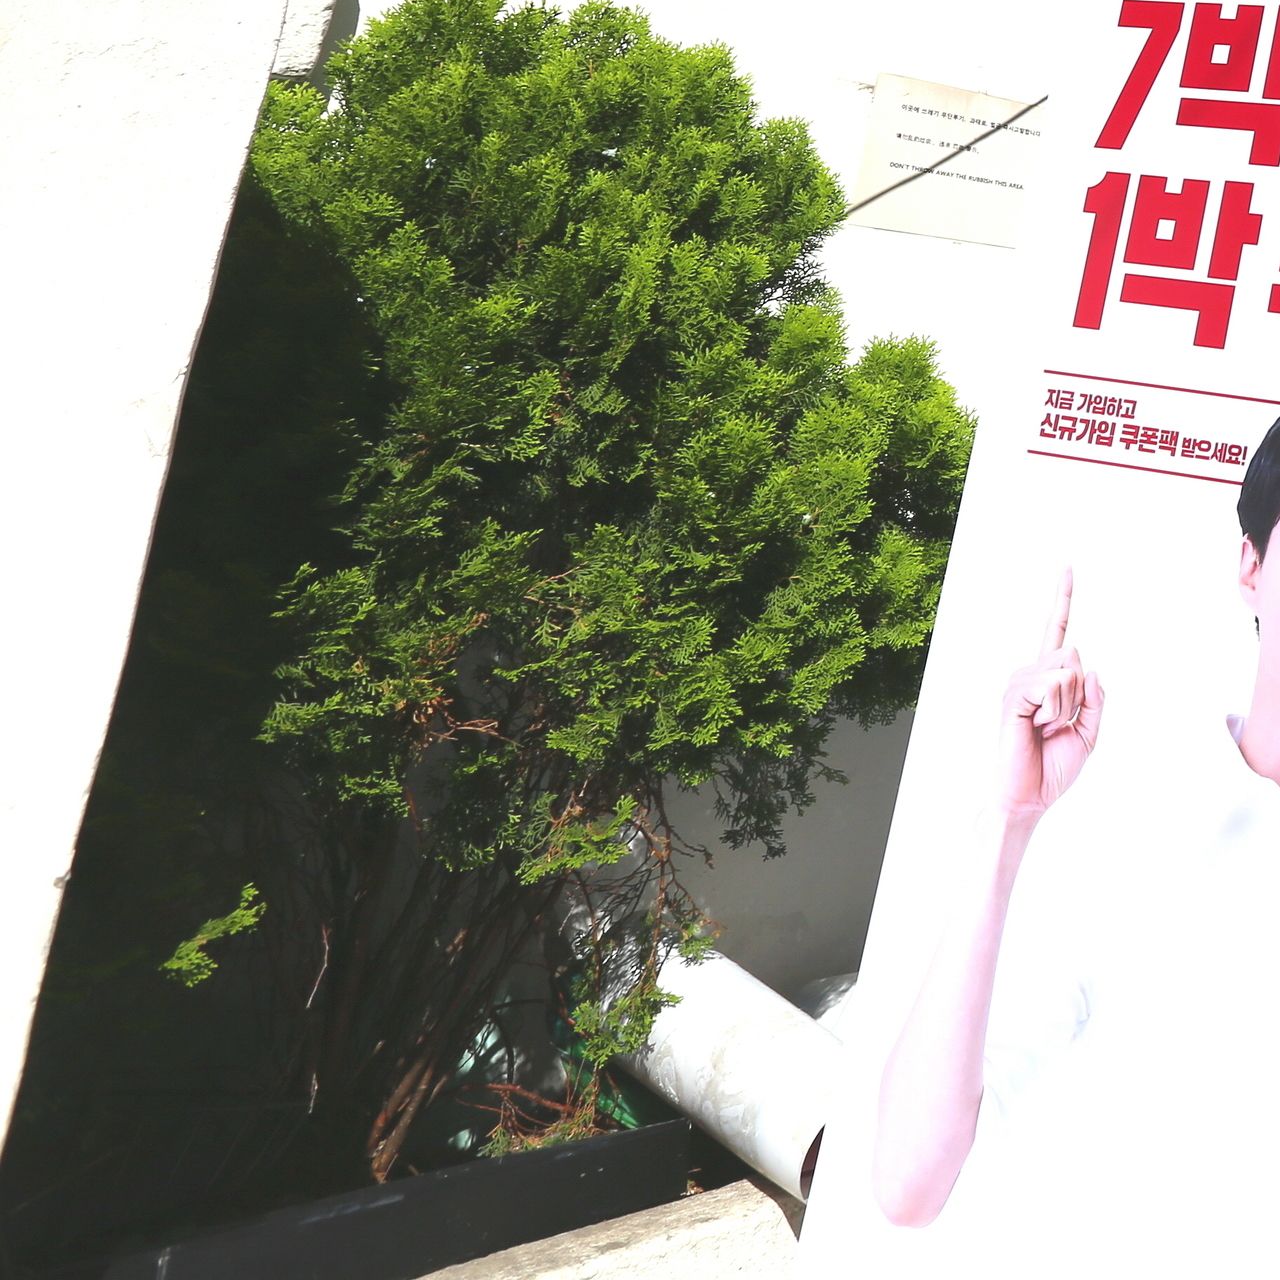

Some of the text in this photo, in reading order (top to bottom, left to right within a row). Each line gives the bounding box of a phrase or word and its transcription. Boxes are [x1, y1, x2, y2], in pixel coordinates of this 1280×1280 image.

[935, 169, 954, 178] AWAY
[956, 173, 967, 181] THE
[968, 175, 994, 185] RUBBISH
[995, 179, 1007, 187] THIS
[1072, 170, 1264, 350] 1박
[1043, 387, 1138, 420] 지금 가입하고
[1039, 412, 1249, 466] 신규가입 쿠폰팩 받으세요!
